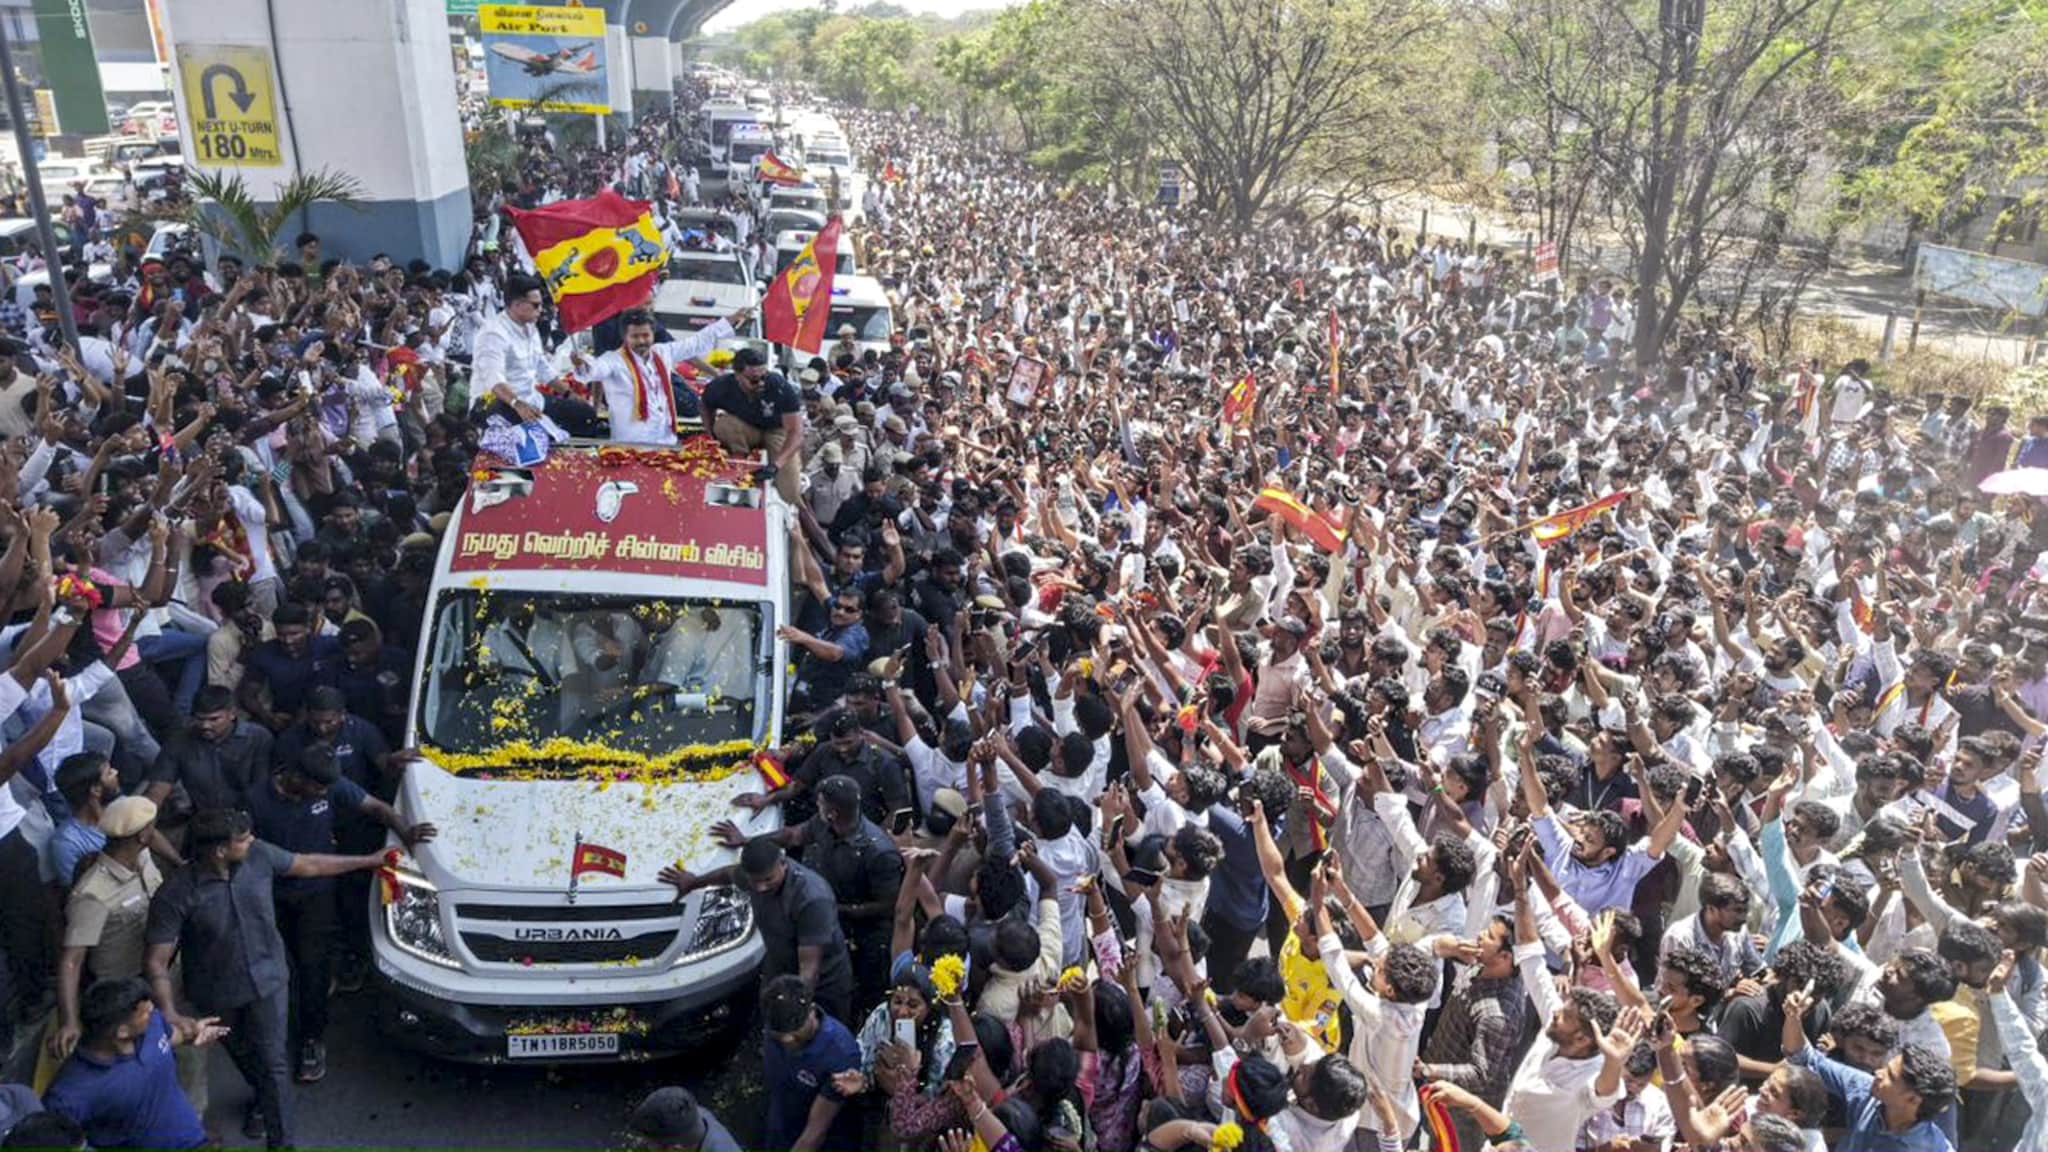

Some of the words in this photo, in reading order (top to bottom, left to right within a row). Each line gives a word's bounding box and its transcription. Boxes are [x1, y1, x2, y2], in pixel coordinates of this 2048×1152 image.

[496, 21, 522, 30] Air
[527, 22, 568, 32] Port
[197, 120, 226, 132] NEXT
[228, 121, 273, 134] U-TURN
[200, 133, 246, 158] 180
[459, 532, 520, 560] நமது
[523, 529, 611, 560] வெற்றிச்
[703, 542, 764, 570] விசில்
[520, 1036, 616, 1052] TN11BR5050
